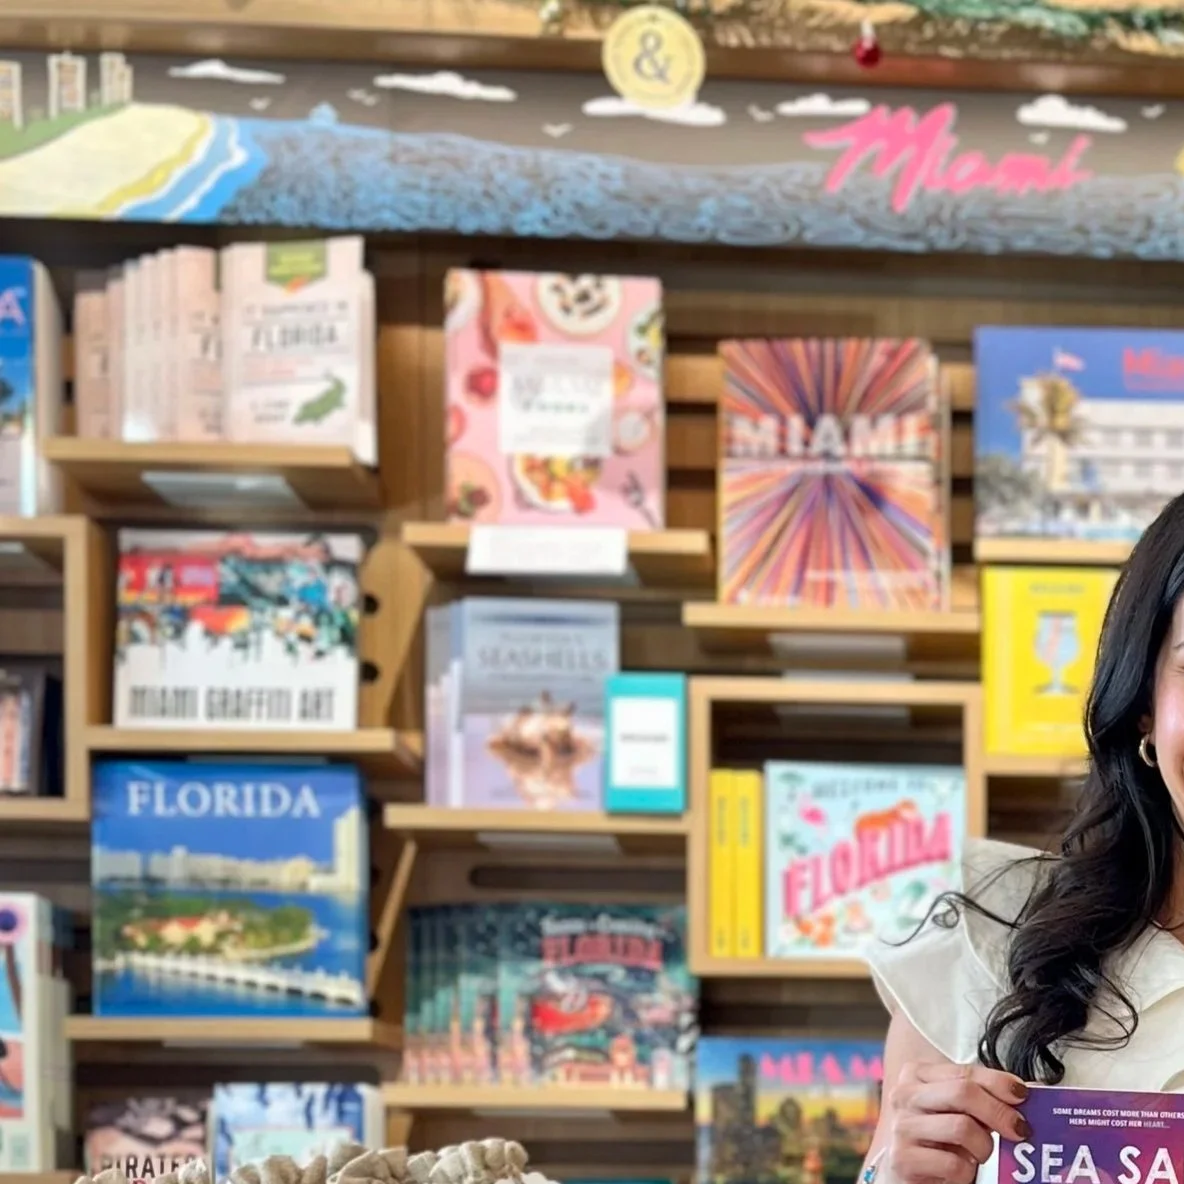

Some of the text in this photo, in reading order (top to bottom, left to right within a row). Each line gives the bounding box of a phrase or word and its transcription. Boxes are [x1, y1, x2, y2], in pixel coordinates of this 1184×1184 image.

[802, 102, 1094, 214] Miami
[731, 413, 932, 456] MIAMI
[205, 686, 292, 721] GRAFFITI
[299, 687, 334, 722] ART
[127, 780, 321, 820] FLORIDA
[781, 811, 953, 919] FLORIDA
[1053, 1107, 1072, 1116] SOME
[1073, 1108, 1101, 1117] DREAMS
[1102, 1109, 1119, 1117] COST
[1120, 1110, 1140, 1118] MORE
[1141, 1110, 1158, 1119] THAN
[1069, 1118, 1087, 1126] HERS
[1088, 1119, 1110, 1127] MIGHT
[1111, 1119, 1128, 1127] COST
[1128, 1120, 1143, 1128] HER
[1011, 1142, 1100, 1184] SEA
